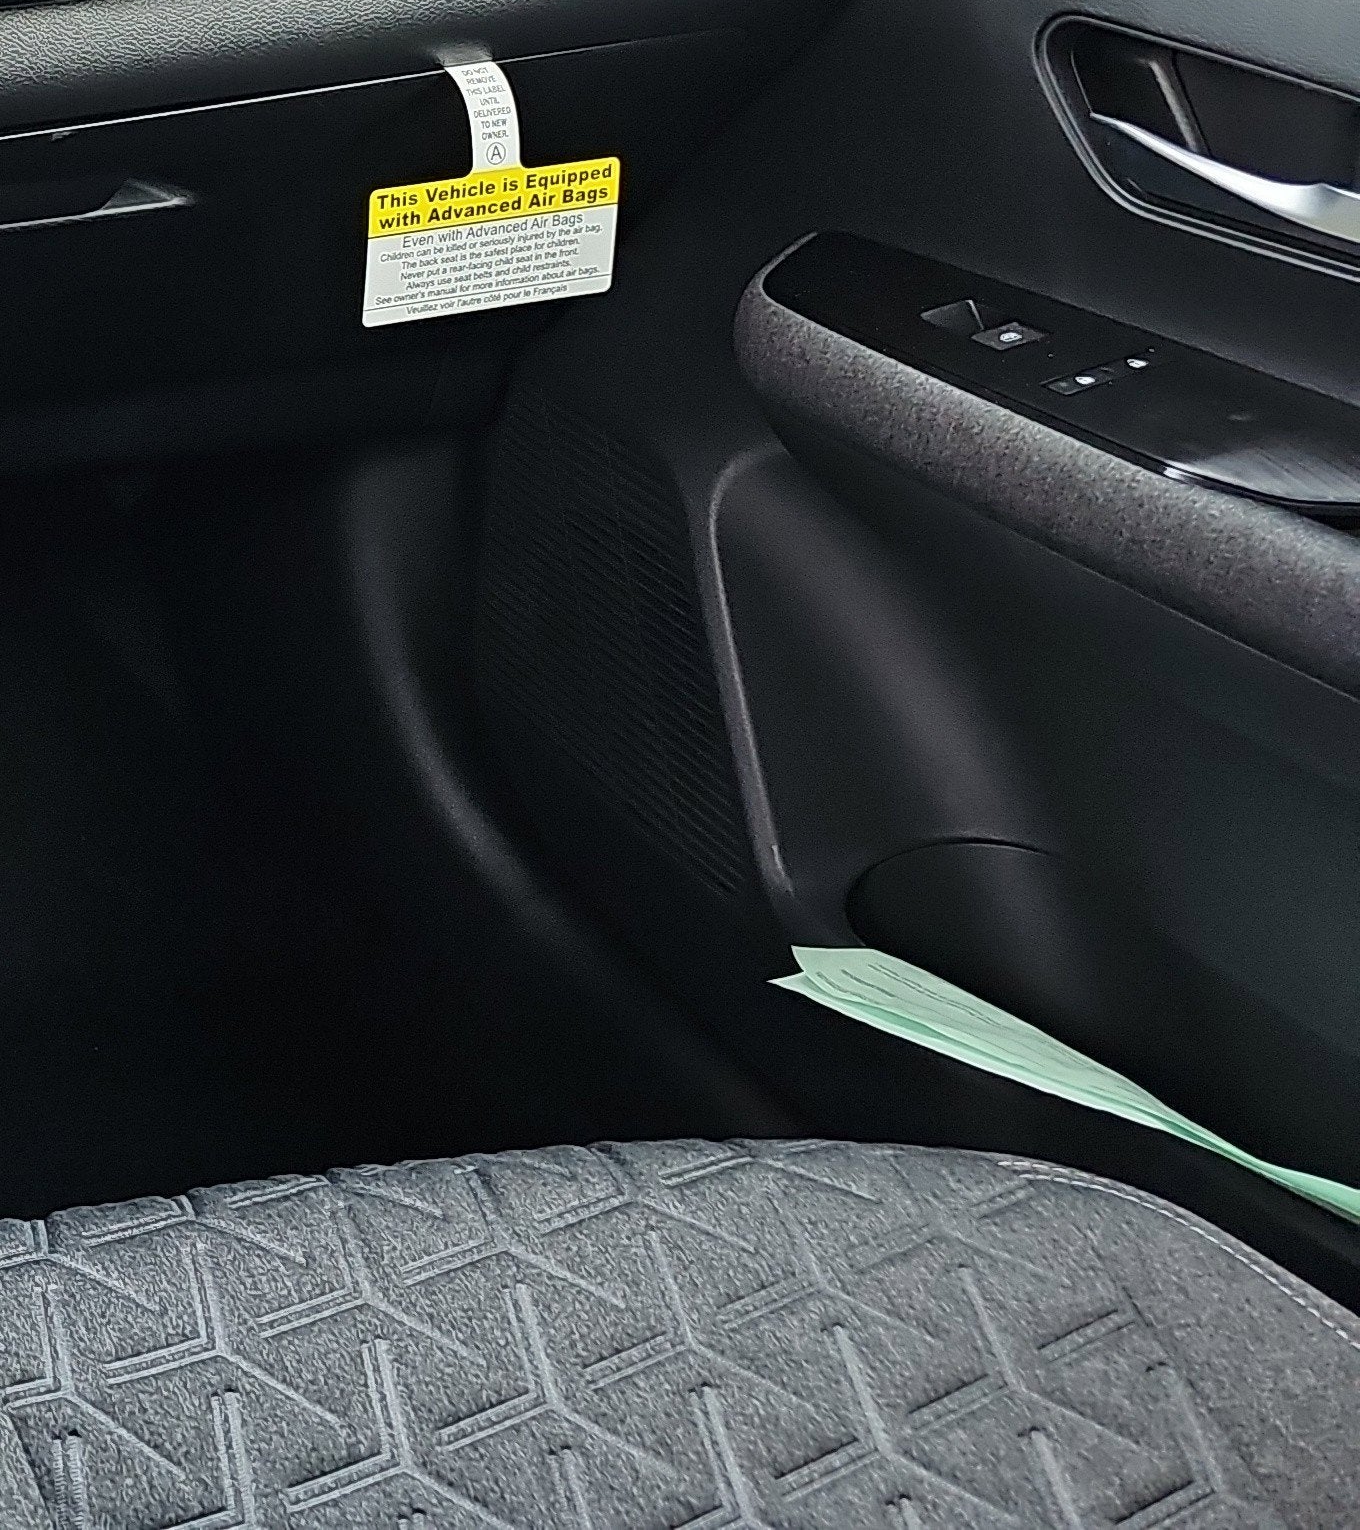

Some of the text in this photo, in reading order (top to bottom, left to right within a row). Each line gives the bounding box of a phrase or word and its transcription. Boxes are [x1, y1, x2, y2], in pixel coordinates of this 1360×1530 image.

[482, 84, 506, 95] LABEL
[480, 118, 507, 129] TO NEW
[377, 163, 613, 210] This Vehicle is Equipped
[379, 185, 609, 230] with Advanced Air Bags
[380, 223, 603, 263] Children can be killed or seriously injured by the air bag.
[402, 213, 584, 249] Even with Advanced Air Bags
[400, 270, 424, 281] Never
[426, 267, 440, 278] put
[441, 267, 448, 275] a
[449, 261, 493, 273] rear-facing
[495, 257, 514, 267] child
[515, 253, 533, 262] seat
[534, 252, 542, 261] in
[544, 250, 557, 259] the
[401, 237, 580, 270] The back seat is the safest place for children.
[375, 296, 393, 306] See
[427, 285, 458, 297] manual
[459, 283, 470, 293] for
[472, 281, 493, 291] more
[541, 271, 565, 281] about
[565, 268, 577, 277] air
[405, 279, 435, 291] Always
[437, 277, 452, 285] use
[454, 271, 472, 281] seat
[473, 270, 493, 281] belts
[495, 266, 511, 277] and
[512, 264, 531, 274] child
[440, 299, 455, 309] voir
[502, 290, 521, 302] pour
[522, 288, 532, 297] le
